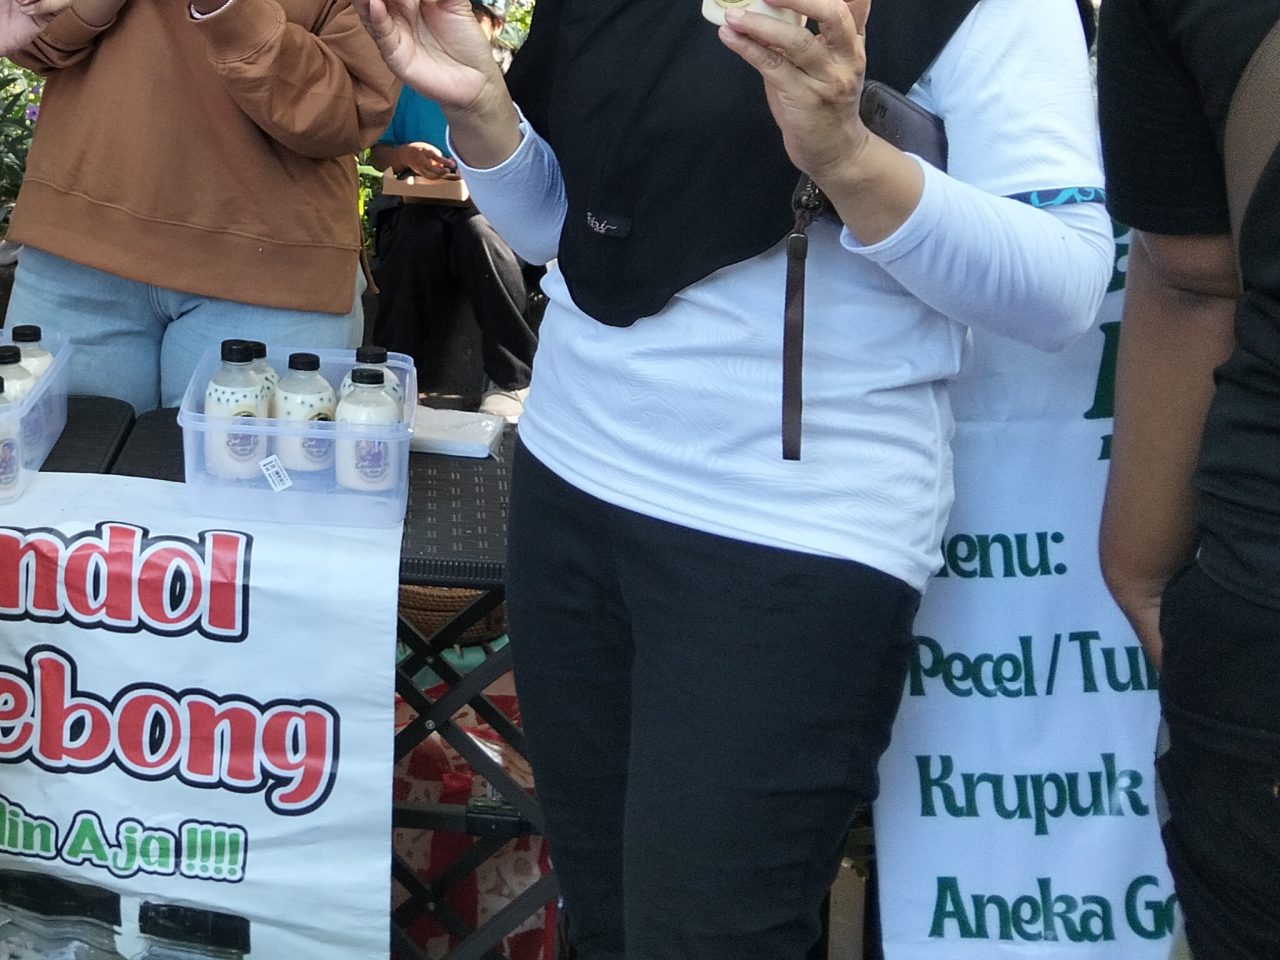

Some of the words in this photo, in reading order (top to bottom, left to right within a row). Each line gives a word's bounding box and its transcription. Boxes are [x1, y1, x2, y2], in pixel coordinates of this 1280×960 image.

[934, 532, 1067, 578] enu:
[910, 635, 1037, 697] Pecel
[914, 752, 1150, 836] Krupuk
[70, 817, 172, 871] Aja
[185, 827, 242, 877] !!!!
[928, 876, 1116, 943] Aneka
